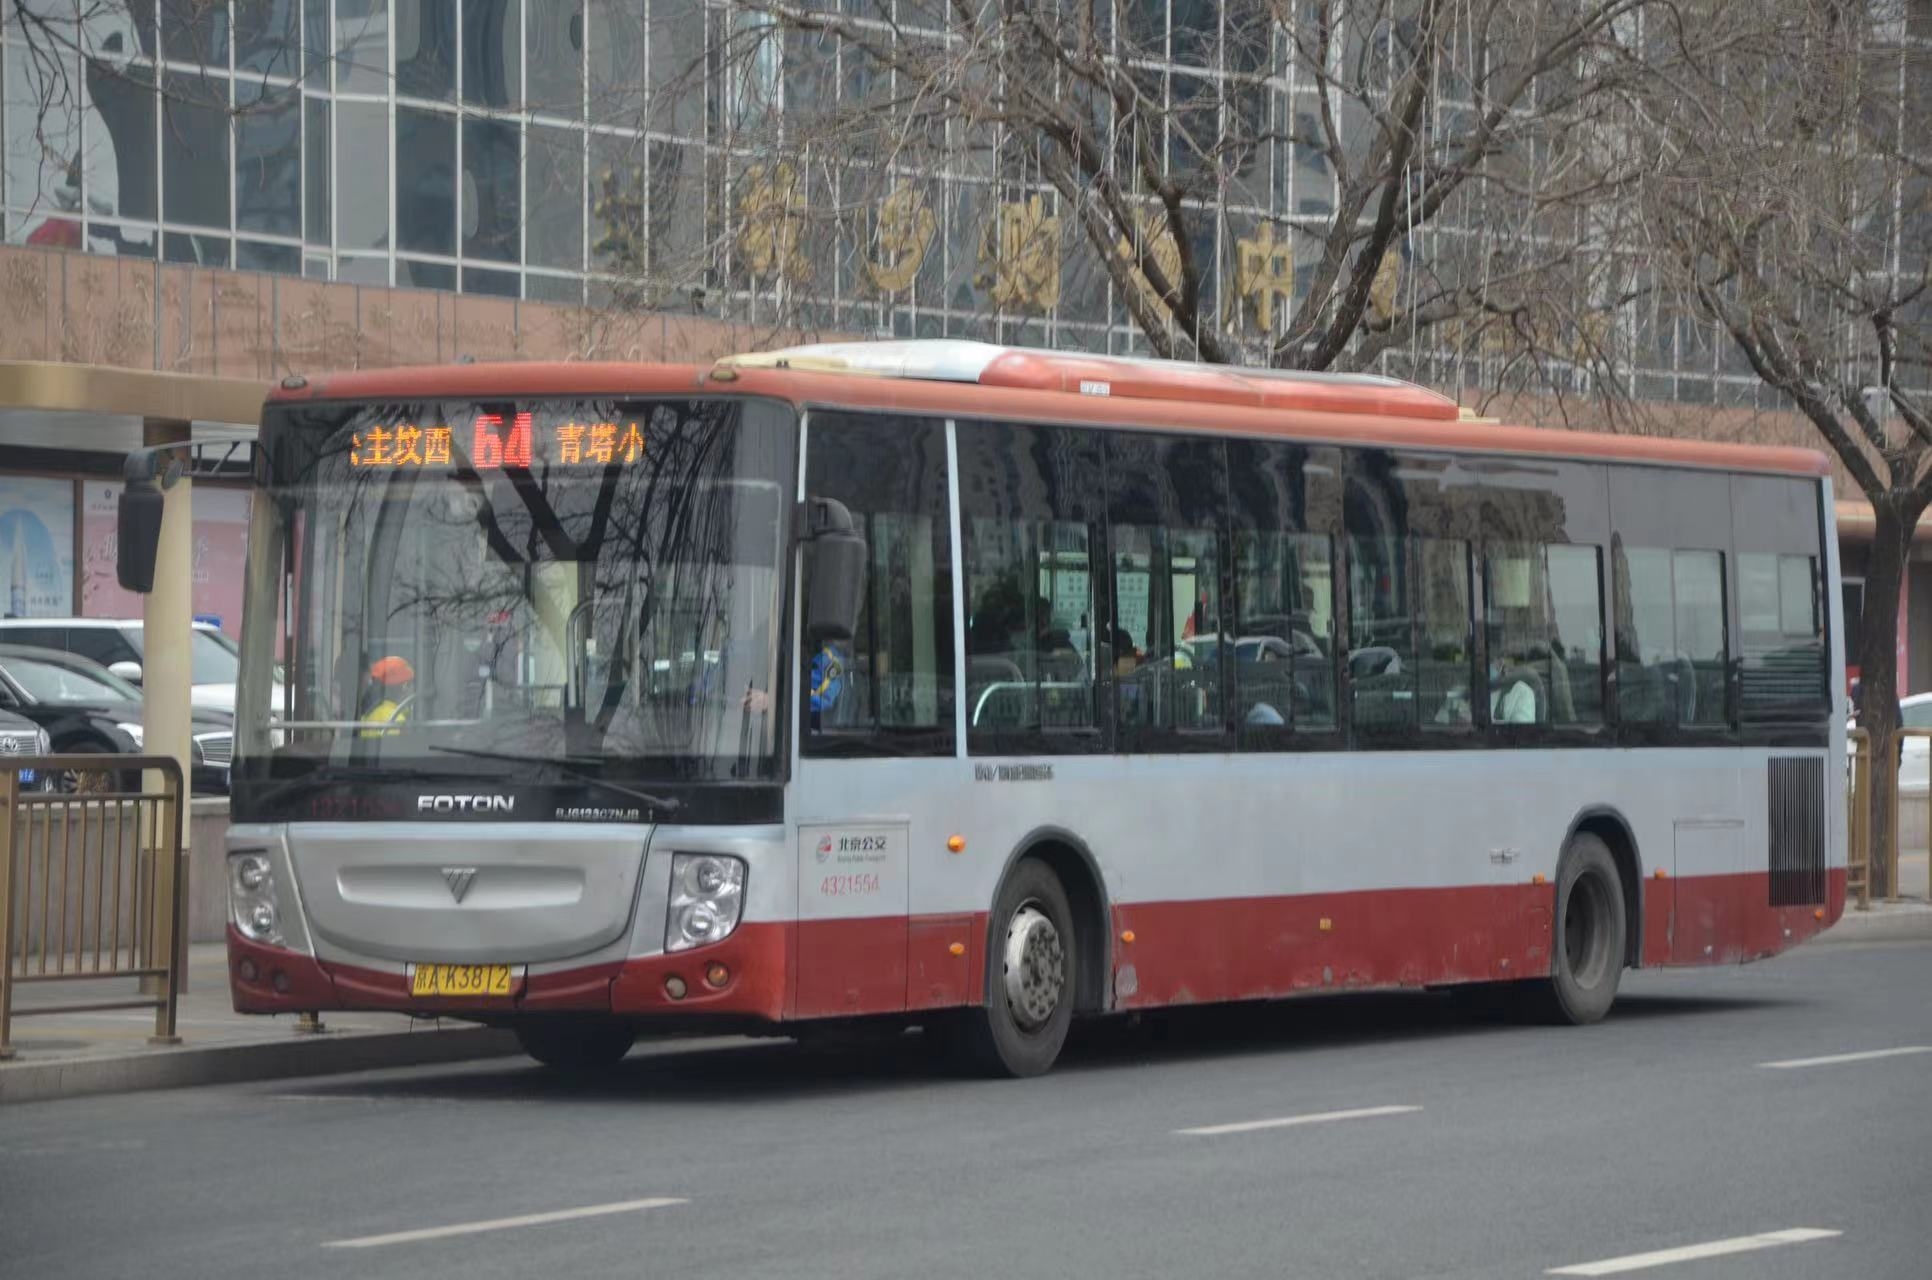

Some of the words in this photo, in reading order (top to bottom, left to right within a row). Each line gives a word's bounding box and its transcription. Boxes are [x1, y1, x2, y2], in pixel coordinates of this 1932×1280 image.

[474, 412, 532, 468] 64
[556, 422, 644, 465] 青塔小
[417, 794, 515, 814] FOTON
[838, 836, 887, 852] 北京公交
[820, 874, 881, 897] 4321554
